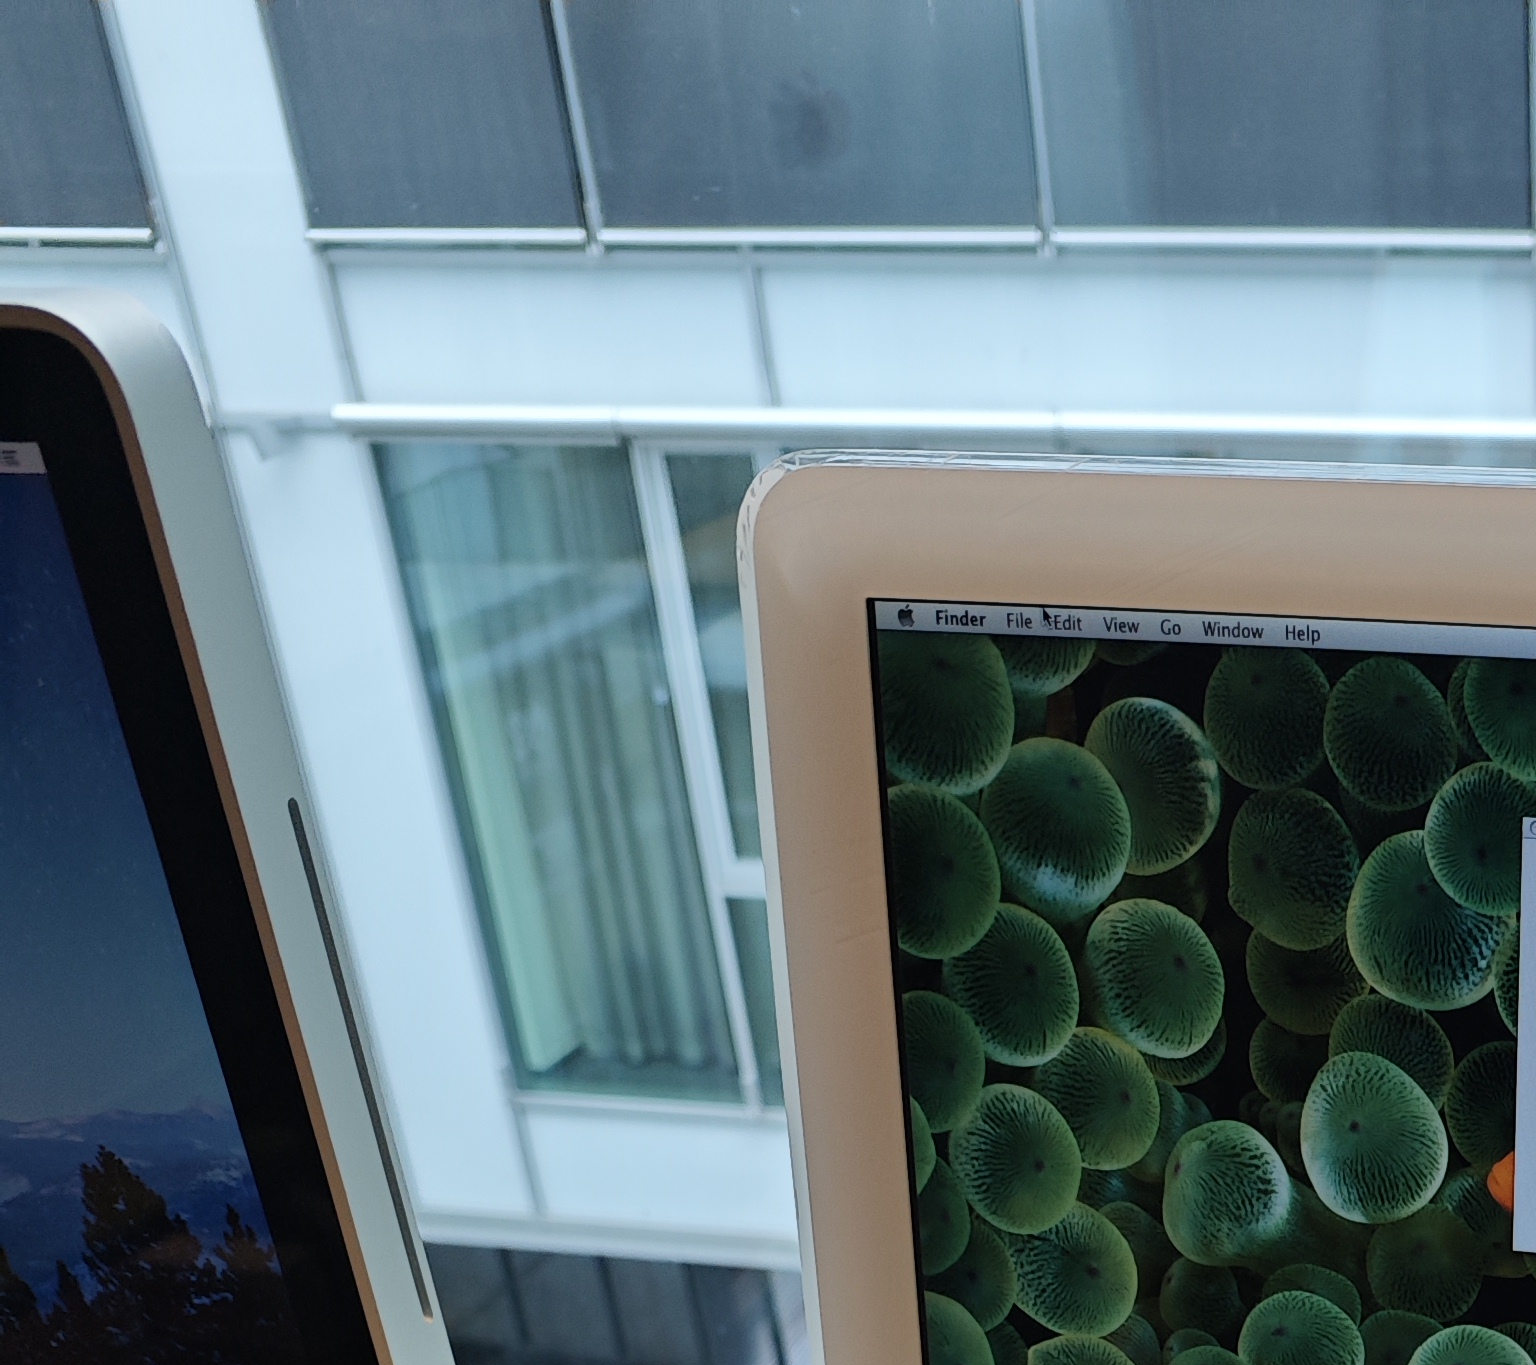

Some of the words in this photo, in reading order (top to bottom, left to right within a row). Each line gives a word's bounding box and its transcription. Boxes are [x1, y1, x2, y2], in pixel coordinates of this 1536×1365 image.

[935, 610, 987, 628] Finder
[1006, 612, 1033, 630] File
[1053, 615, 1082, 632] Edit
[1102, 616, 1140, 634] View
[1160, 619, 1182, 636] Go
[1202, 620, 1264, 640] Window
[1284, 624, 1321, 643] Help
